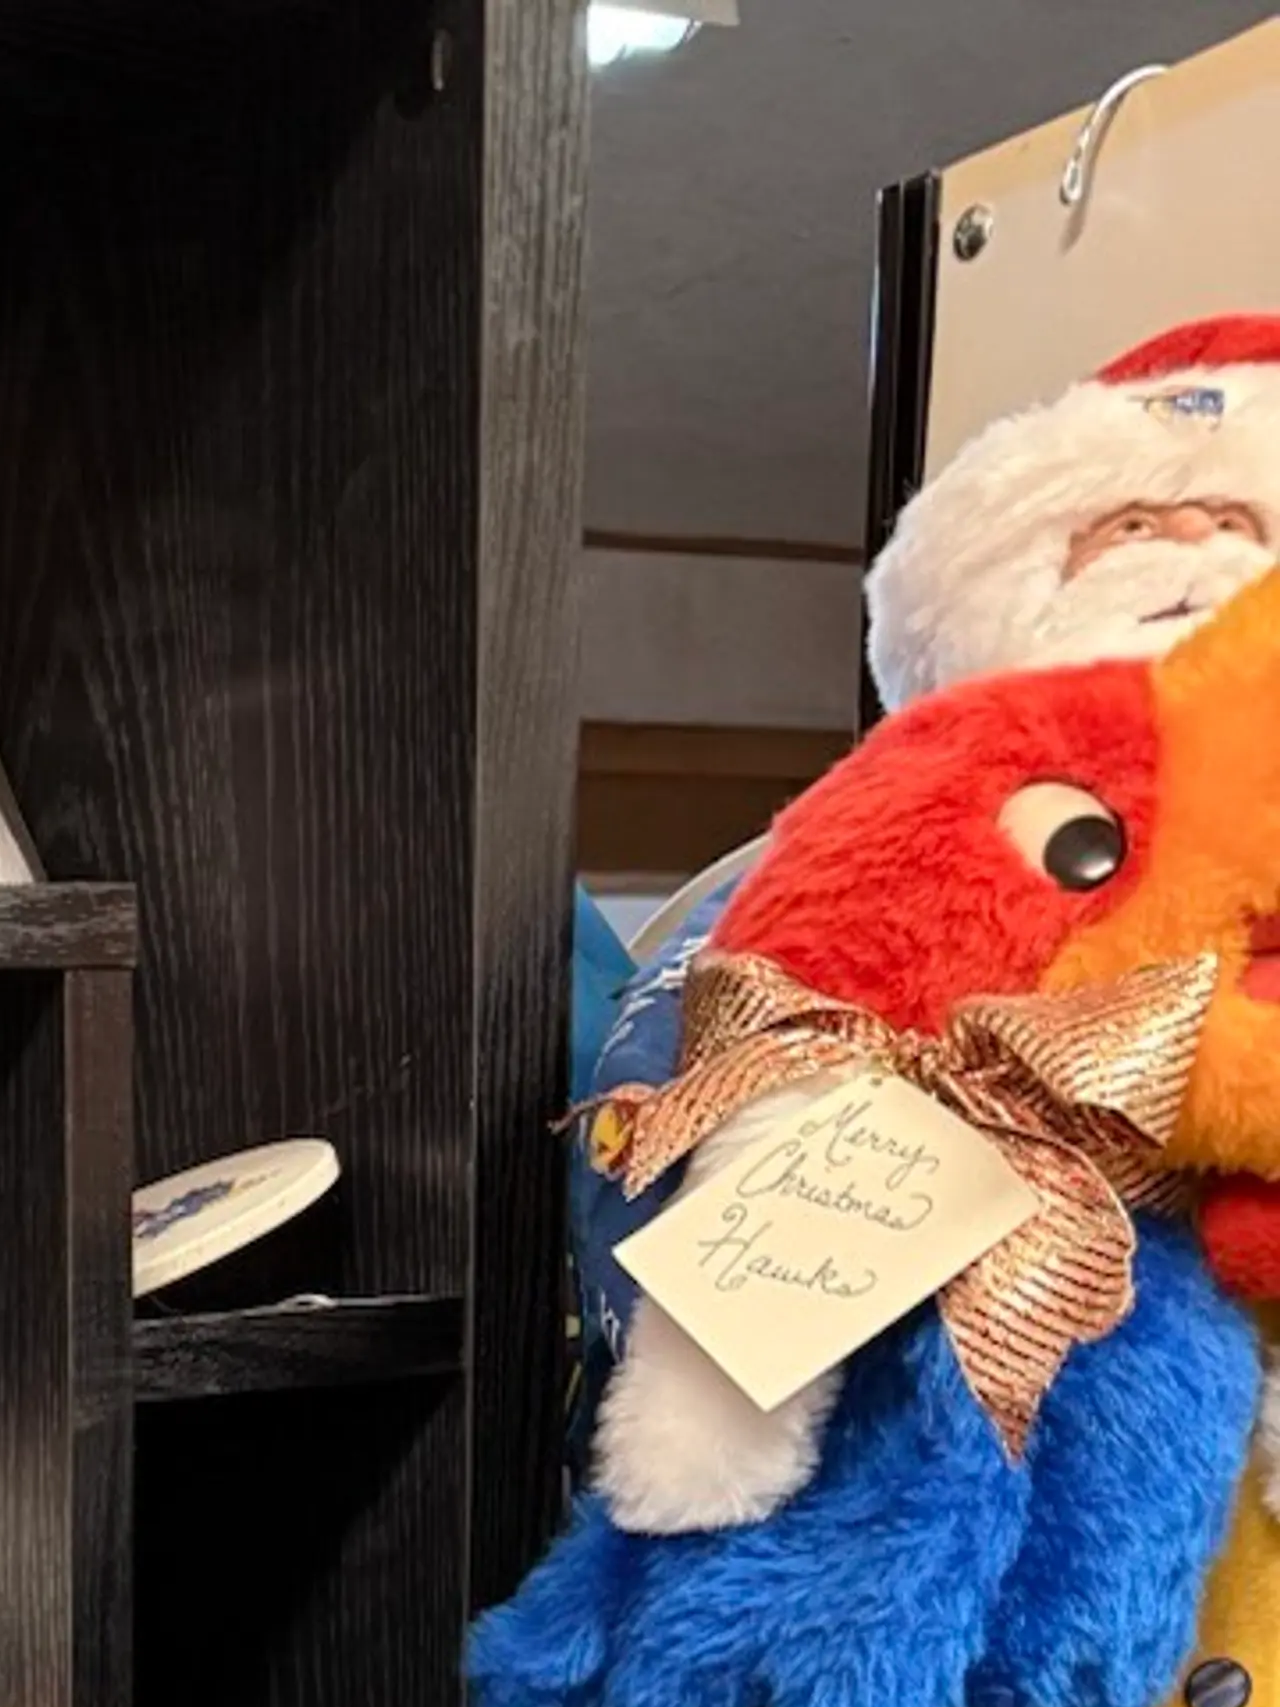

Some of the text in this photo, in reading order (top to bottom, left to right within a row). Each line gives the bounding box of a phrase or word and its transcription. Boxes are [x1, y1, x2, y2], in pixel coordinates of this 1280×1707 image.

[734, 1138, 933, 1231] Christmas
[798, 1100, 940, 1190] Merry
[696, 1202, 878, 1299] Hawks
